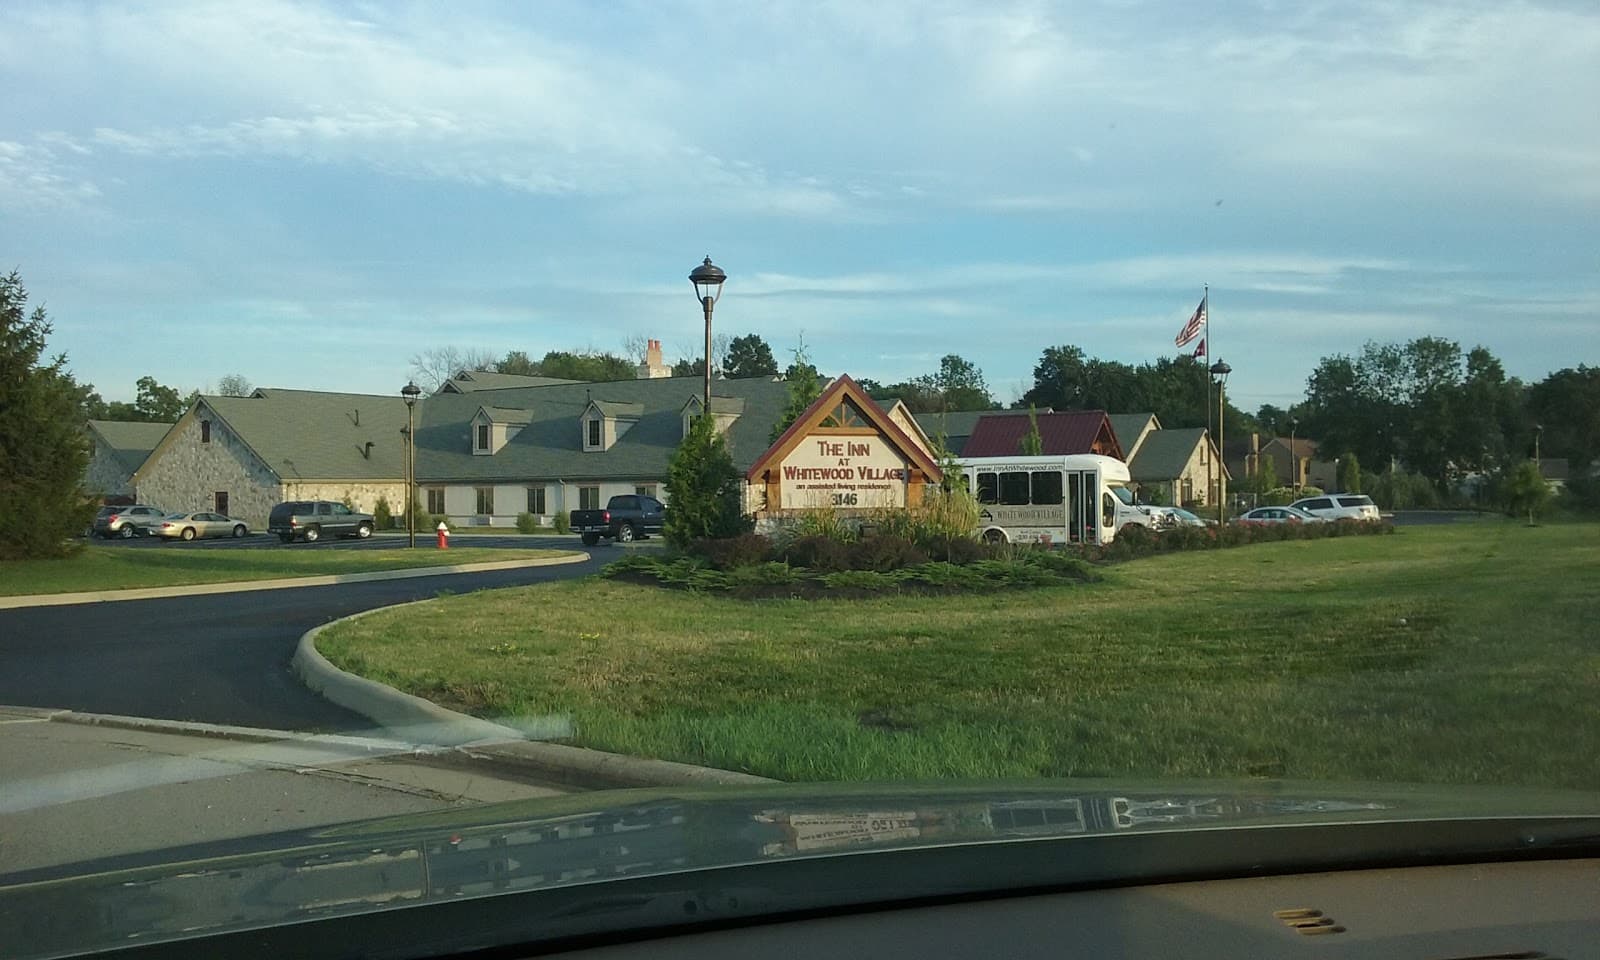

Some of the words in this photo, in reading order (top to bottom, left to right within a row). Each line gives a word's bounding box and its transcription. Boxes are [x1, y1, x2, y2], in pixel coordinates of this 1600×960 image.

[817, 441, 843, 456] THE
[847, 441, 870, 456] INN
[838, 458, 850, 466] AT
[783, 466, 854, 480] WHITEWOOD
[857, 466, 905, 480] VILLAGE
[807, 482, 836, 490] assisted
[837, 482, 856, 491] living
[857, 482, 891, 490] residence
[831, 493, 858, 506] 3146
